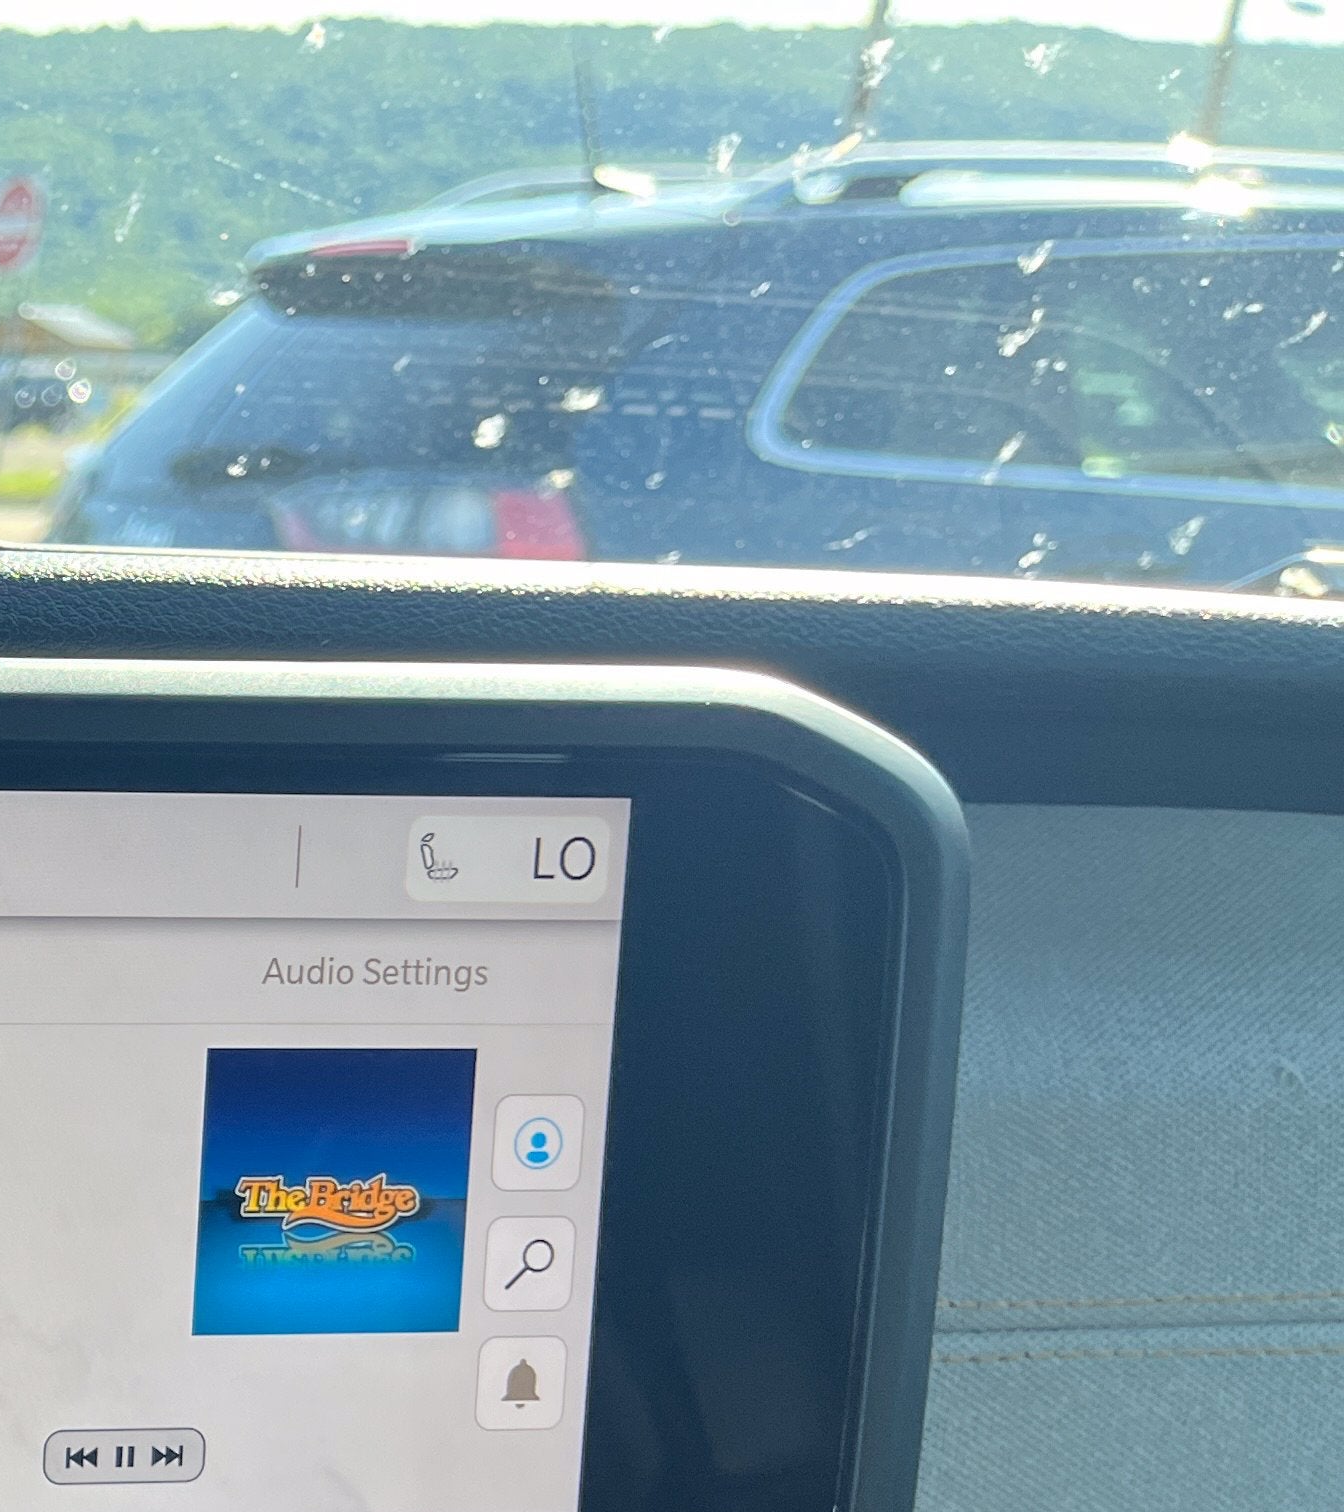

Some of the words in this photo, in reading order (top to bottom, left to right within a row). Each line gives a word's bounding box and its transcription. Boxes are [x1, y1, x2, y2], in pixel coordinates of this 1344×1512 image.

[533, 836, 597, 881] LO
[262, 957, 354, 986] Audio
[362, 957, 489, 992] Settings
